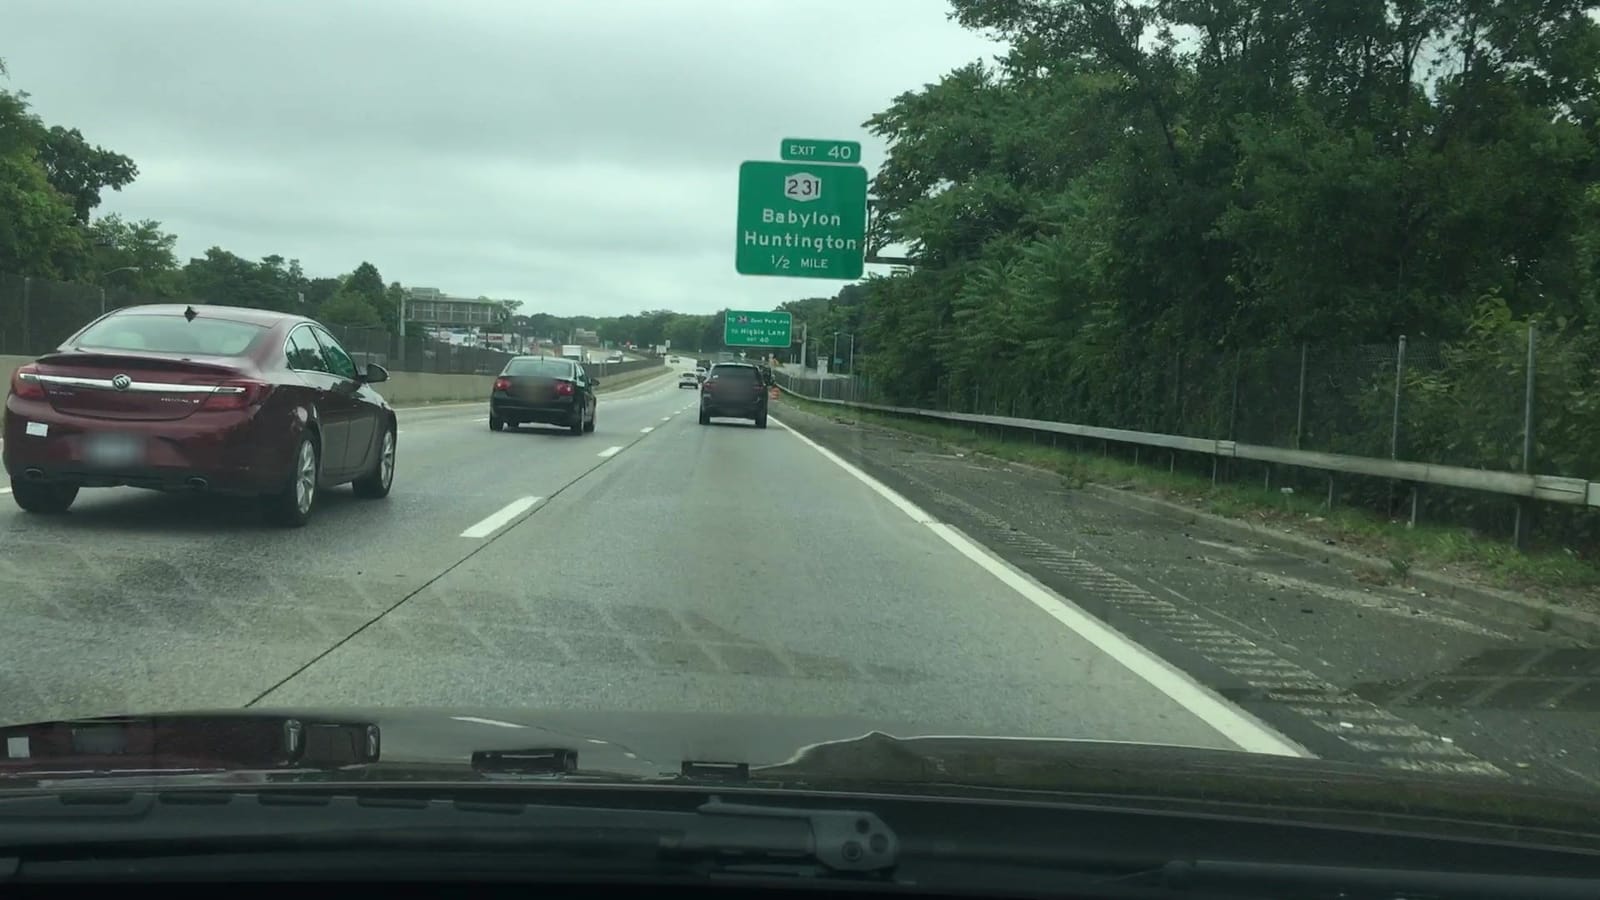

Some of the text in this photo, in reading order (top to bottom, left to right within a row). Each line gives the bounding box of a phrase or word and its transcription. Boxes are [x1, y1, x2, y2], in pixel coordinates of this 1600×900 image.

[790, 145, 851, 159] EXIT 40
[787, 179, 819, 196] 231
[762, 208, 841, 228] Babylon
[744, 230, 857, 252] Huntington
[771, 254, 829, 269] 1/2 MILE
